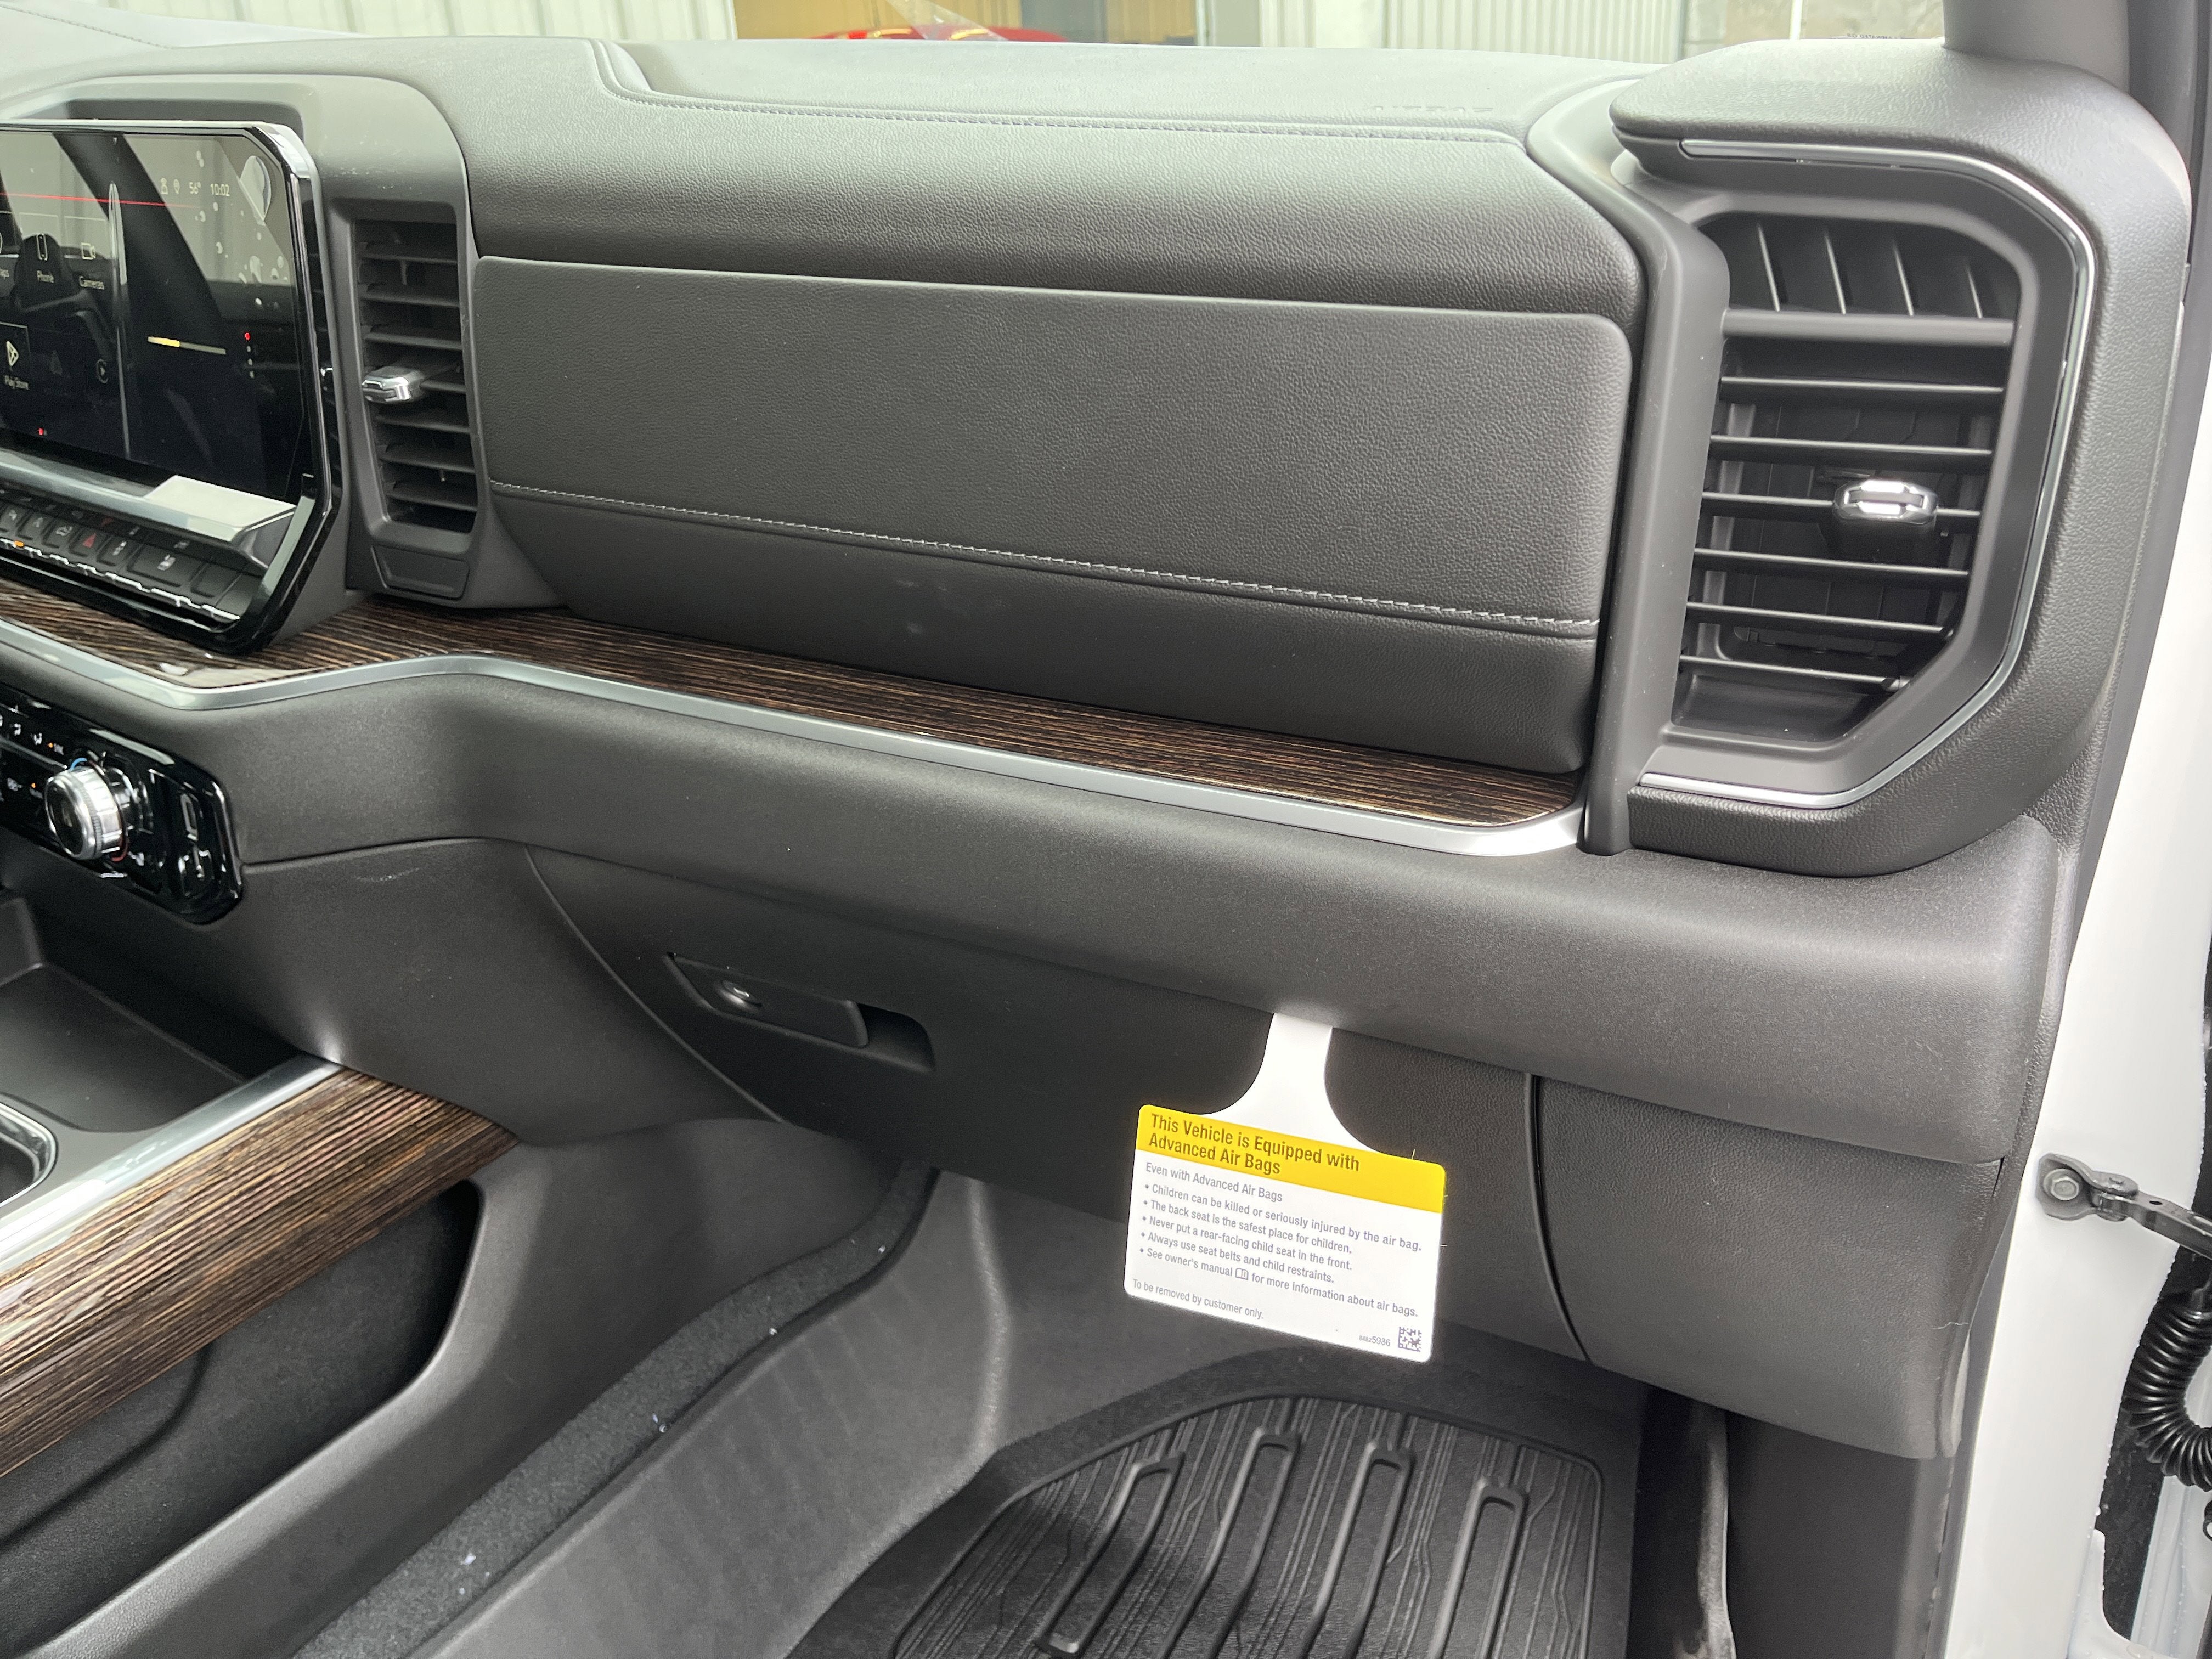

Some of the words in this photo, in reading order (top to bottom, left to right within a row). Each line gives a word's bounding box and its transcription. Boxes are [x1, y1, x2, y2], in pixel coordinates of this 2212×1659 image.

[210, 183, 230, 196] 10:02
[1149, 1133, 1216, 1160] Advanced
[1219, 1148, 1241, 1165] Air
[1245, 1154, 1280, 1175] Bags
[1151, 1113, 1178, 1133] This
[1183, 1120, 1233, 1144] Vehicle
[1238, 1132, 1249, 1147] is
[1254, 1136, 1322, 1163] Equipped
[1327, 1153, 1359, 1171] with
[1146, 1162, 1167, 1176] Even
[1170, 1169, 1190, 1181] with
[1192, 1173, 1239, 1192] Advanced
[1242, 1183, 1256, 1195] Air
[1259, 1187, 1283, 1202] Bags
[1149, 1216, 1173, 1231] Never
[1176, 1223, 1190, 1234] put
[1193, 1227, 1198, 1235] a
[1200, 1229, 1249, 1249] rear-facing
[1251, 1240, 1273, 1253] child
[1276, 1246, 1296, 1259] seat
[1298, 1249, 1307, 1261] in
[1310, 1252, 1324, 1264] the
[1327, 1256, 1352, 1271] front.
[1152, 1184, 1189, 1200] Children
[1192, 1194, 1207, 1205] can
[1211, 1197, 1222, 1208] be
[1224, 1200, 1250, 1214] killed
[1252, 1208, 1263, 1217] or
[1265, 1211, 1308, 1229] seriously
[1311, 1219, 1345, 1235] injured
[1348, 1227, 1360, 1240] by
[1363, 1231, 1379, 1242] the
[1383, 1235, 1397, 1246] air
[1400, 1237, 1421, 1252] bag.
[1152, 1200, 1166, 1212] The
[1169, 1204, 1189, 1217] back
[1191, 1211, 1210, 1222] seat
[1212, 1214, 1220, 1224] is
[1222, 1216, 1236, 1228] the
[1239, 1221, 1266, 1235] safest
[1269, 1227, 1293, 1240] place
[1296, 1233, 1309, 1244] for
[1311, 1236, 1352, 1254] children.
[1147, 1248, 1163, 1259] See
[1165, 1254, 1198, 1268] owner's
[1201, 1262, 1232, 1277] manual
[1251, 1272, 1264, 1284] for
[1267, 1278, 1289, 1289] more
[1292, 1282, 1345, 1302] information
[1347, 1295, 1374, 1308] about
[1376, 1300, 1390, 1311] air
[1392, 1303, 1418, 1317] bags.
[1148, 1232, 1178, 1248] Always
[1181, 1242, 1196, 1251] use
[1198, 1245, 1217, 1256] seat
[1220, 1248, 1241, 1262] belts
[1243, 1256, 1260, 1266] and
[1263, 1259, 1284, 1272] child
[1287, 1265, 1334, 1283] restraints.
[1133, 1278, 1142, 1289] To
[1144, 1282, 1154, 1292] be
[1155, 1286, 1190, 1301] removed
[1192, 1294, 1201, 1306] by
[1204, 1297, 1242, 1314] customer
[1245, 1308, 1263, 1320] only.
[1358, 1335, 1391, 1346] 84825986
